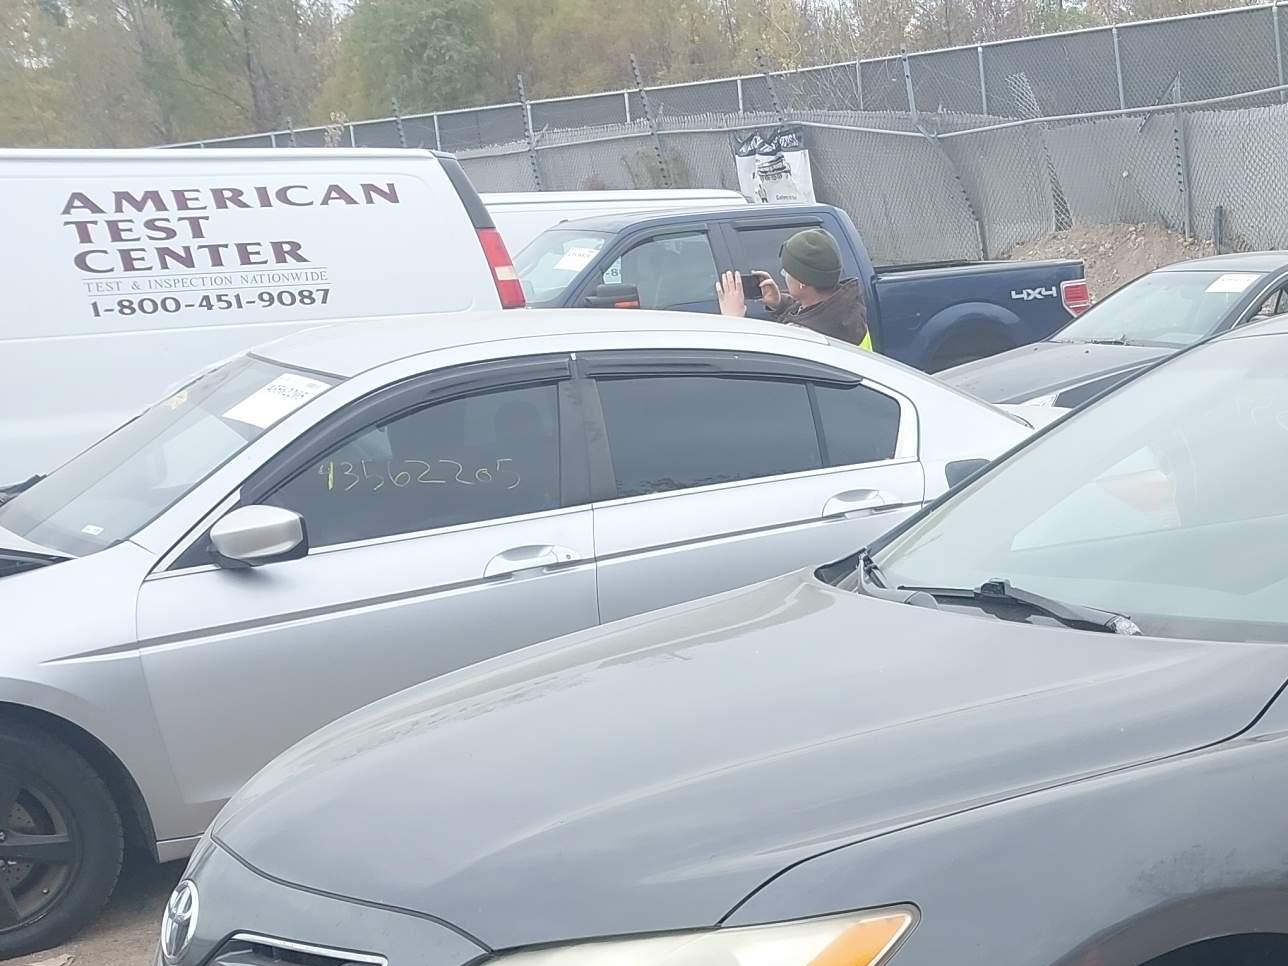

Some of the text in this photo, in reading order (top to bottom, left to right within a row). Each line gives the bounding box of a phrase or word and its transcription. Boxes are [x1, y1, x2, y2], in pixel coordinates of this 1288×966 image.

[61, 183, 400, 215] AMERICAN
[63, 216, 210, 244] TEST
[73, 240, 311, 274] CENTER
[84, 270, 329, 293] TEST & INSPECTION NATIONWIDE
[91, 288, 331, 318] 1-800-451-9087
